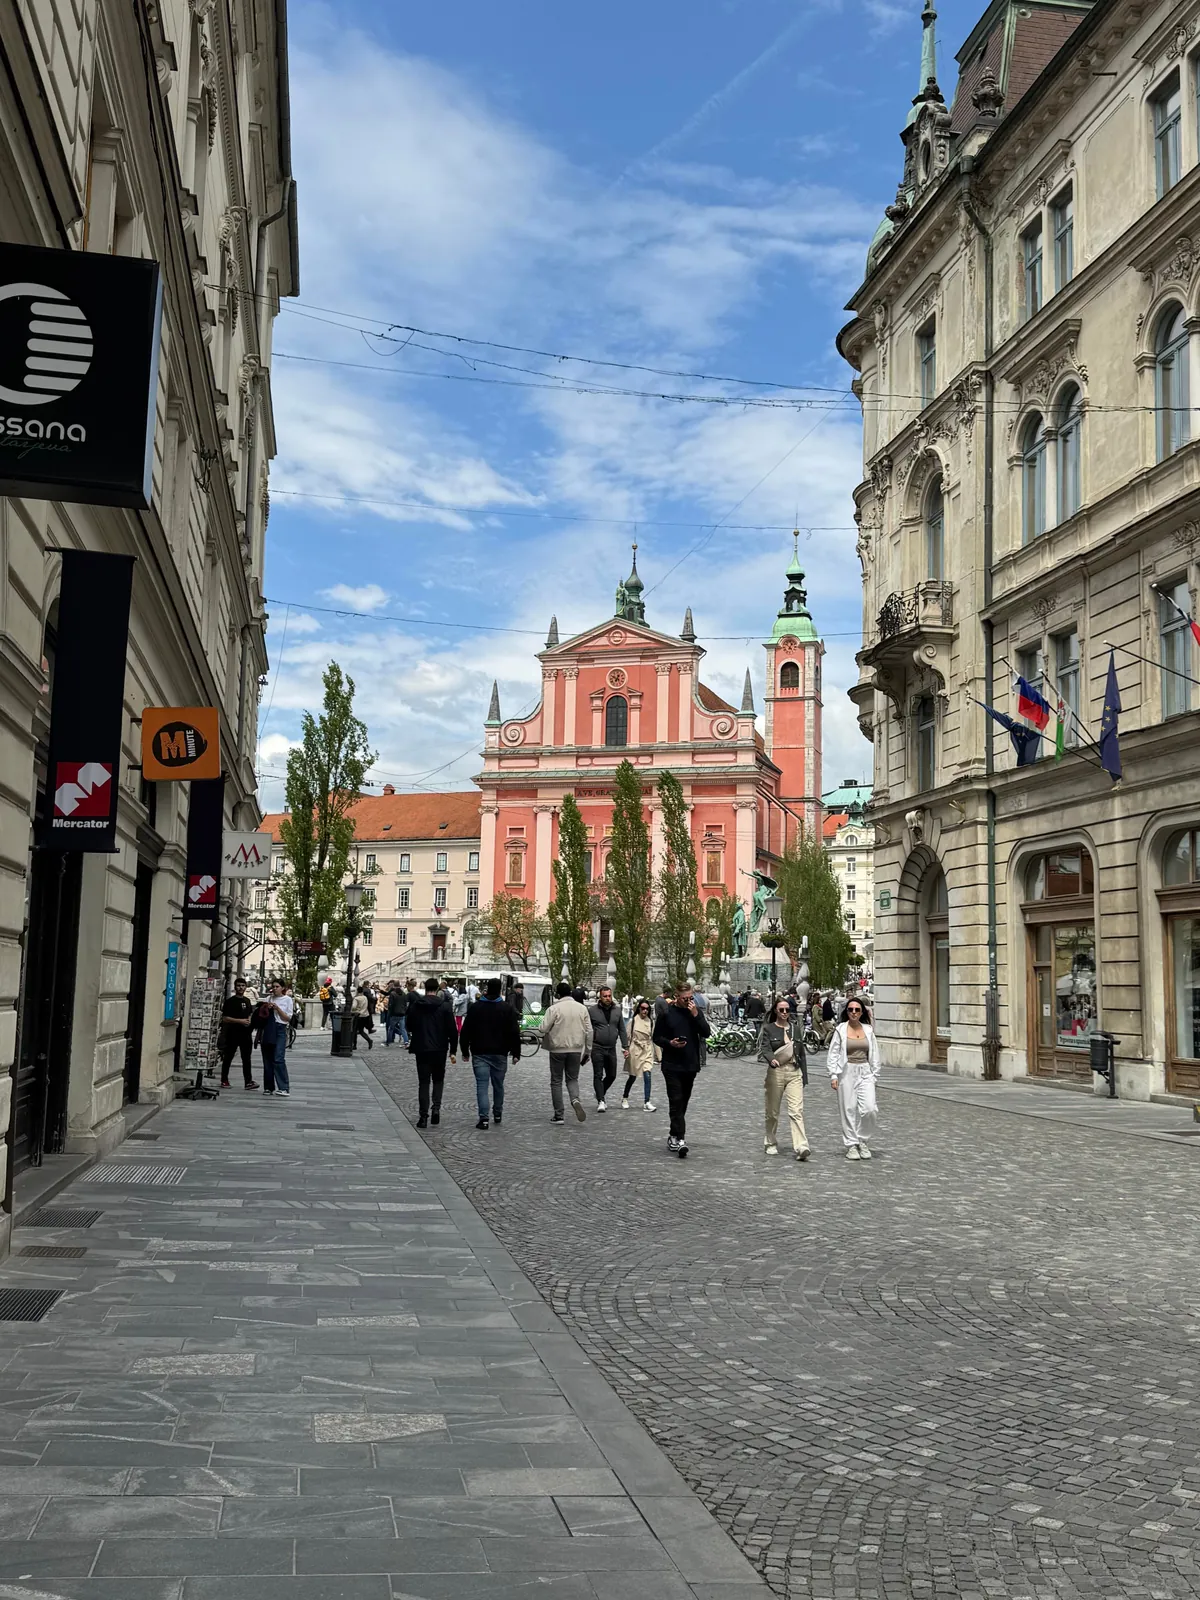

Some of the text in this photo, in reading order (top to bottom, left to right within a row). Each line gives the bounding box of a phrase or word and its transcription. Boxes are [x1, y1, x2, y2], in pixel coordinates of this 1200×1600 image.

[160, 730, 187, 760] M
[185, 729, 197, 758] MINUTE
[52, 818, 109, 829] Mercator
